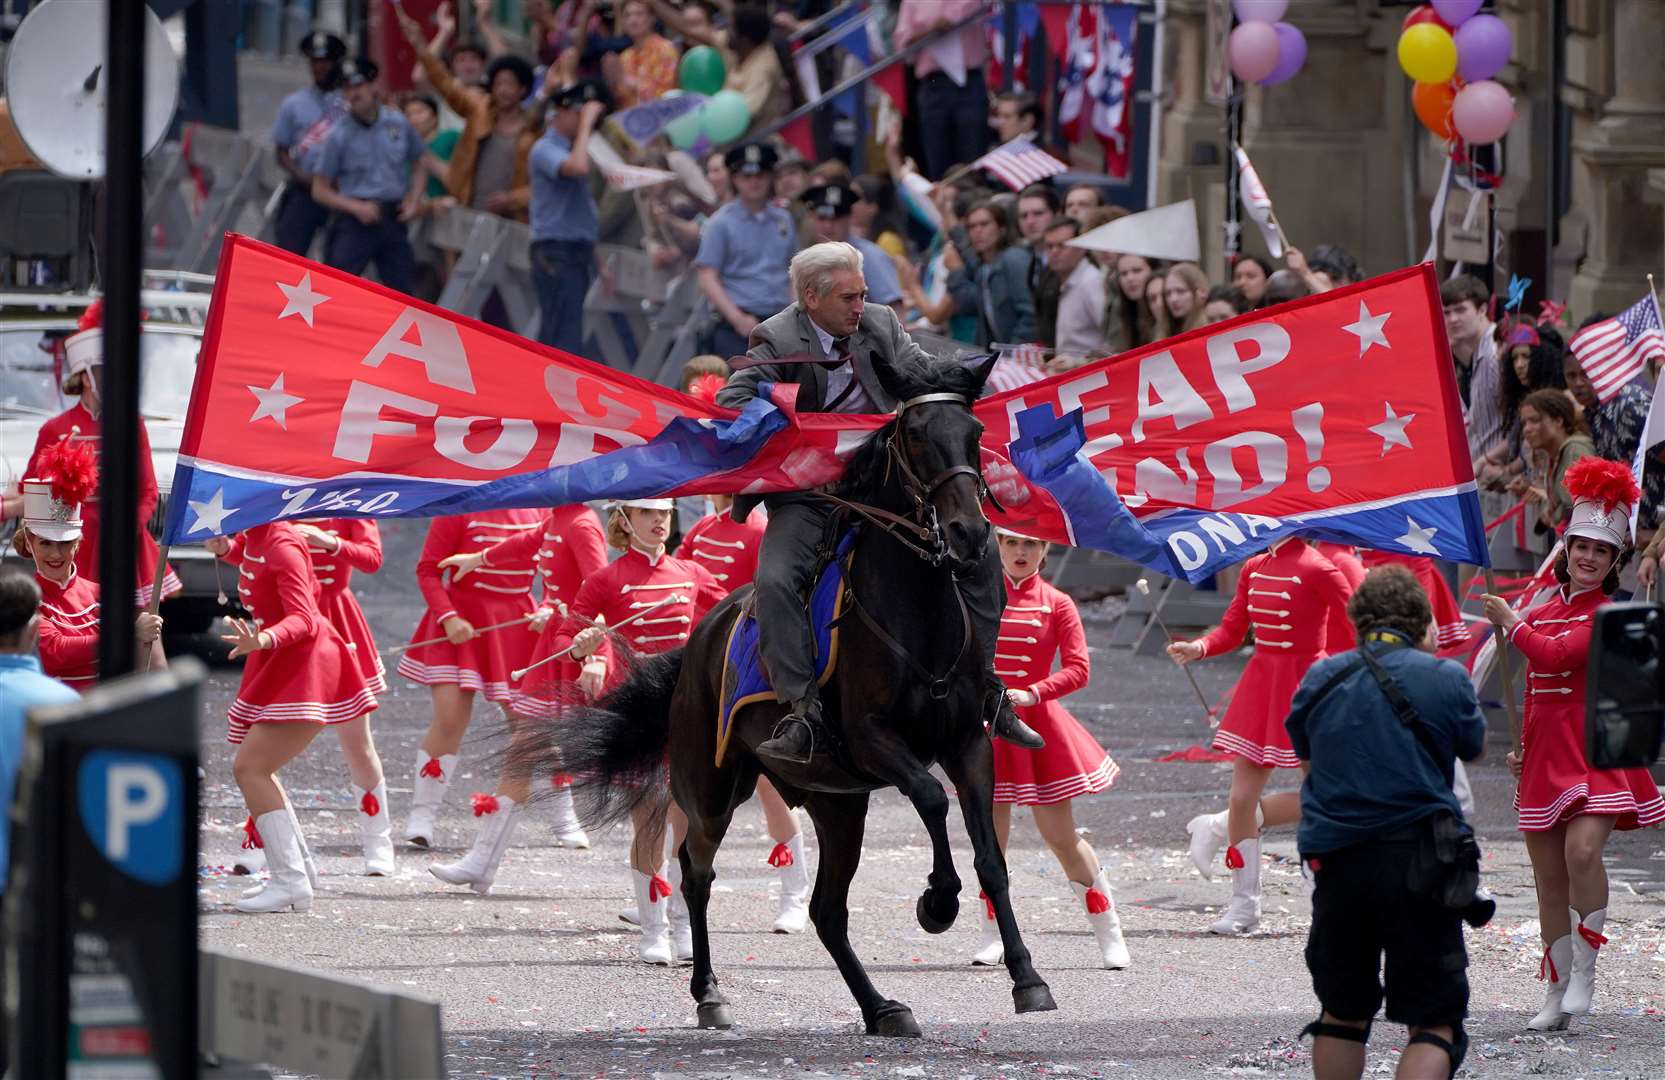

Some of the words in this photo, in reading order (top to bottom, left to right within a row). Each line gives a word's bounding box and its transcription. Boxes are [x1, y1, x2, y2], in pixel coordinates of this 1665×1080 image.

[361, 306, 477, 394] A
[1100, 402, 1332, 509] ND!
[106, 763, 168, 861] P
